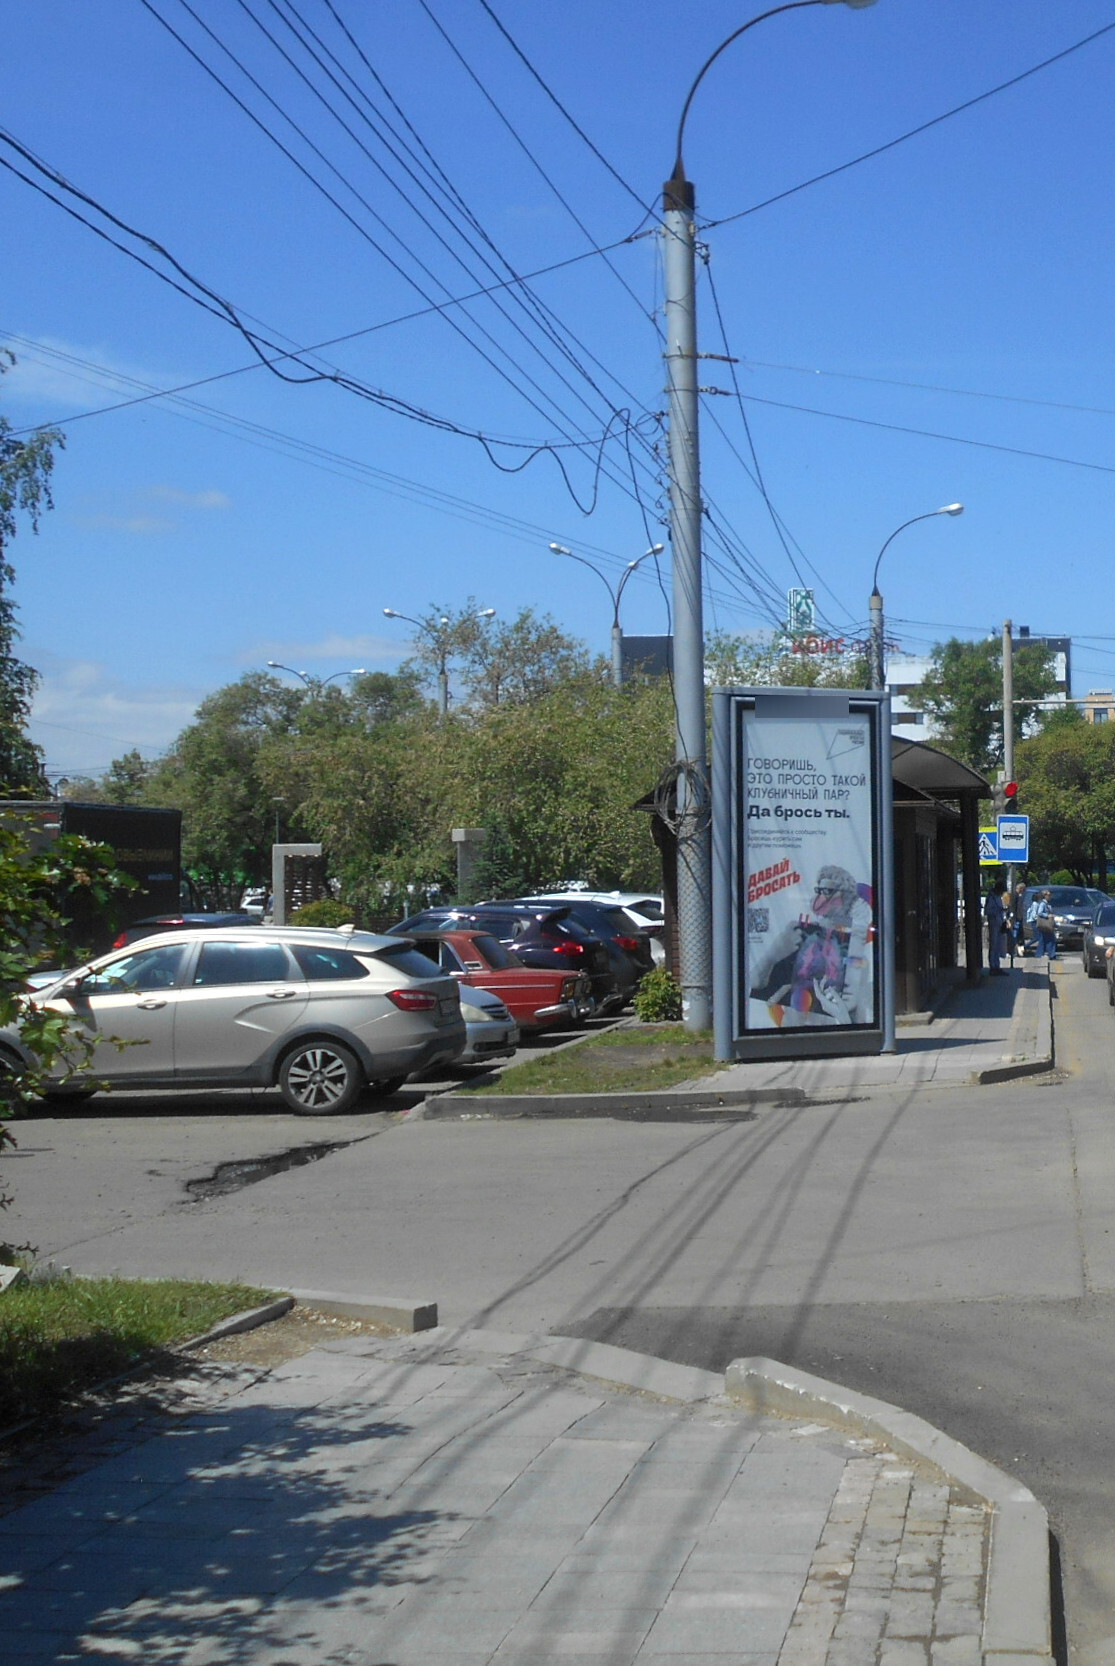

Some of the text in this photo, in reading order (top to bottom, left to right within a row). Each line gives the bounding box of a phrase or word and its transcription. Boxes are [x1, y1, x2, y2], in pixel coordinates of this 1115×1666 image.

[747, 757, 817, 772] ГОВОРИШЬ,
[747, 773, 867, 787] ЭТО ПРОСТО ТАКОЙ
[823, 789, 850, 801] ПАР?
[747, 805, 850, 821] Да брось ты.
[748, 857, 791, 890] ДАВАЙ
[747, 871, 801, 904] БРОСАТЬ
